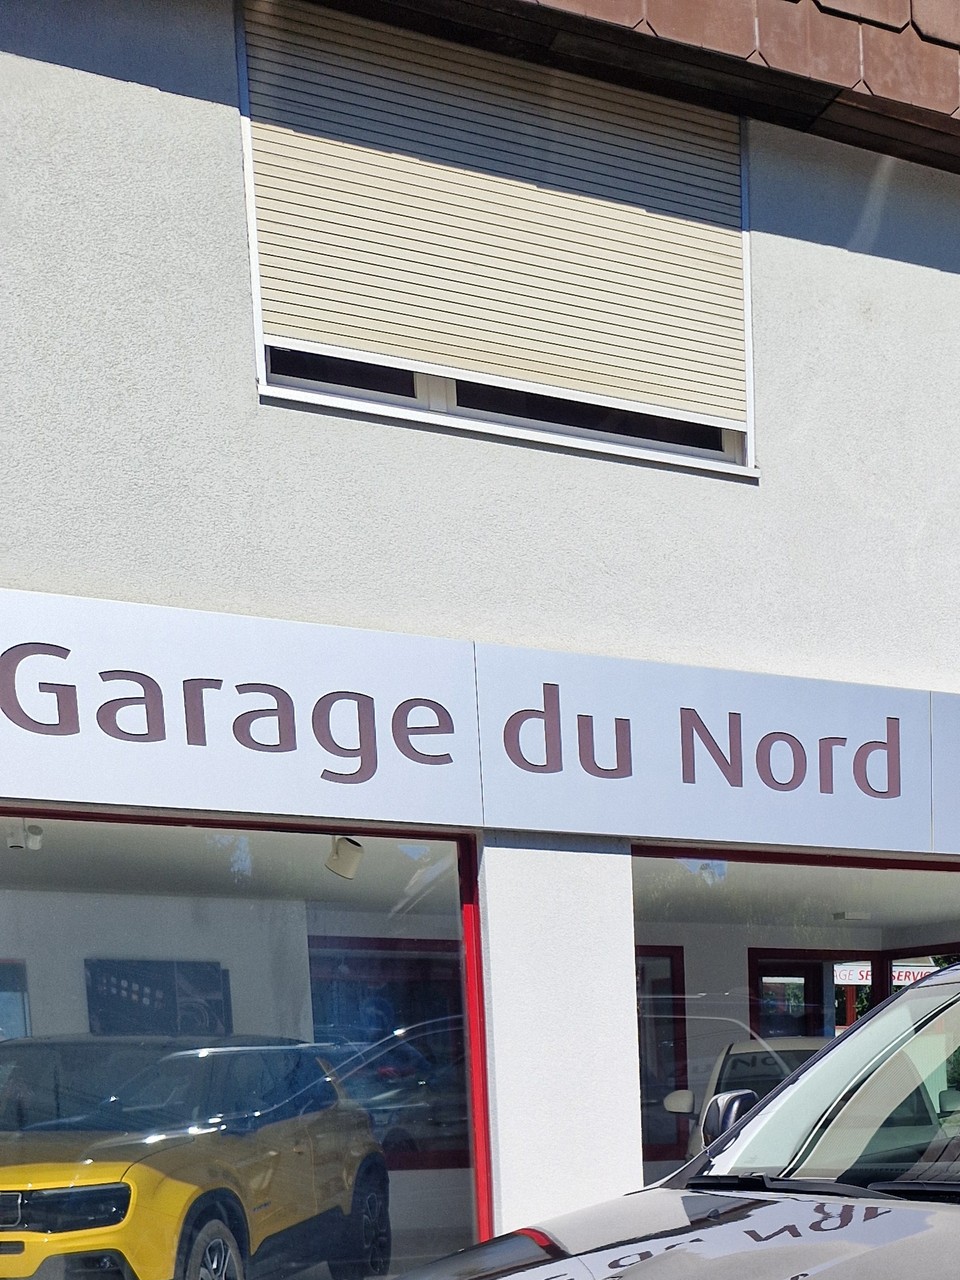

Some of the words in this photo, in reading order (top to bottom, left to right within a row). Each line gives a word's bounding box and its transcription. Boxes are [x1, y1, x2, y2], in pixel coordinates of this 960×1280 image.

[0, 642, 455, 784] Garage
[502, 683, 631, 779] du
[680, 707, 901, 799] Nord
[834, 969, 854, 981] AGE
[858, 969, 871, 981] SE
